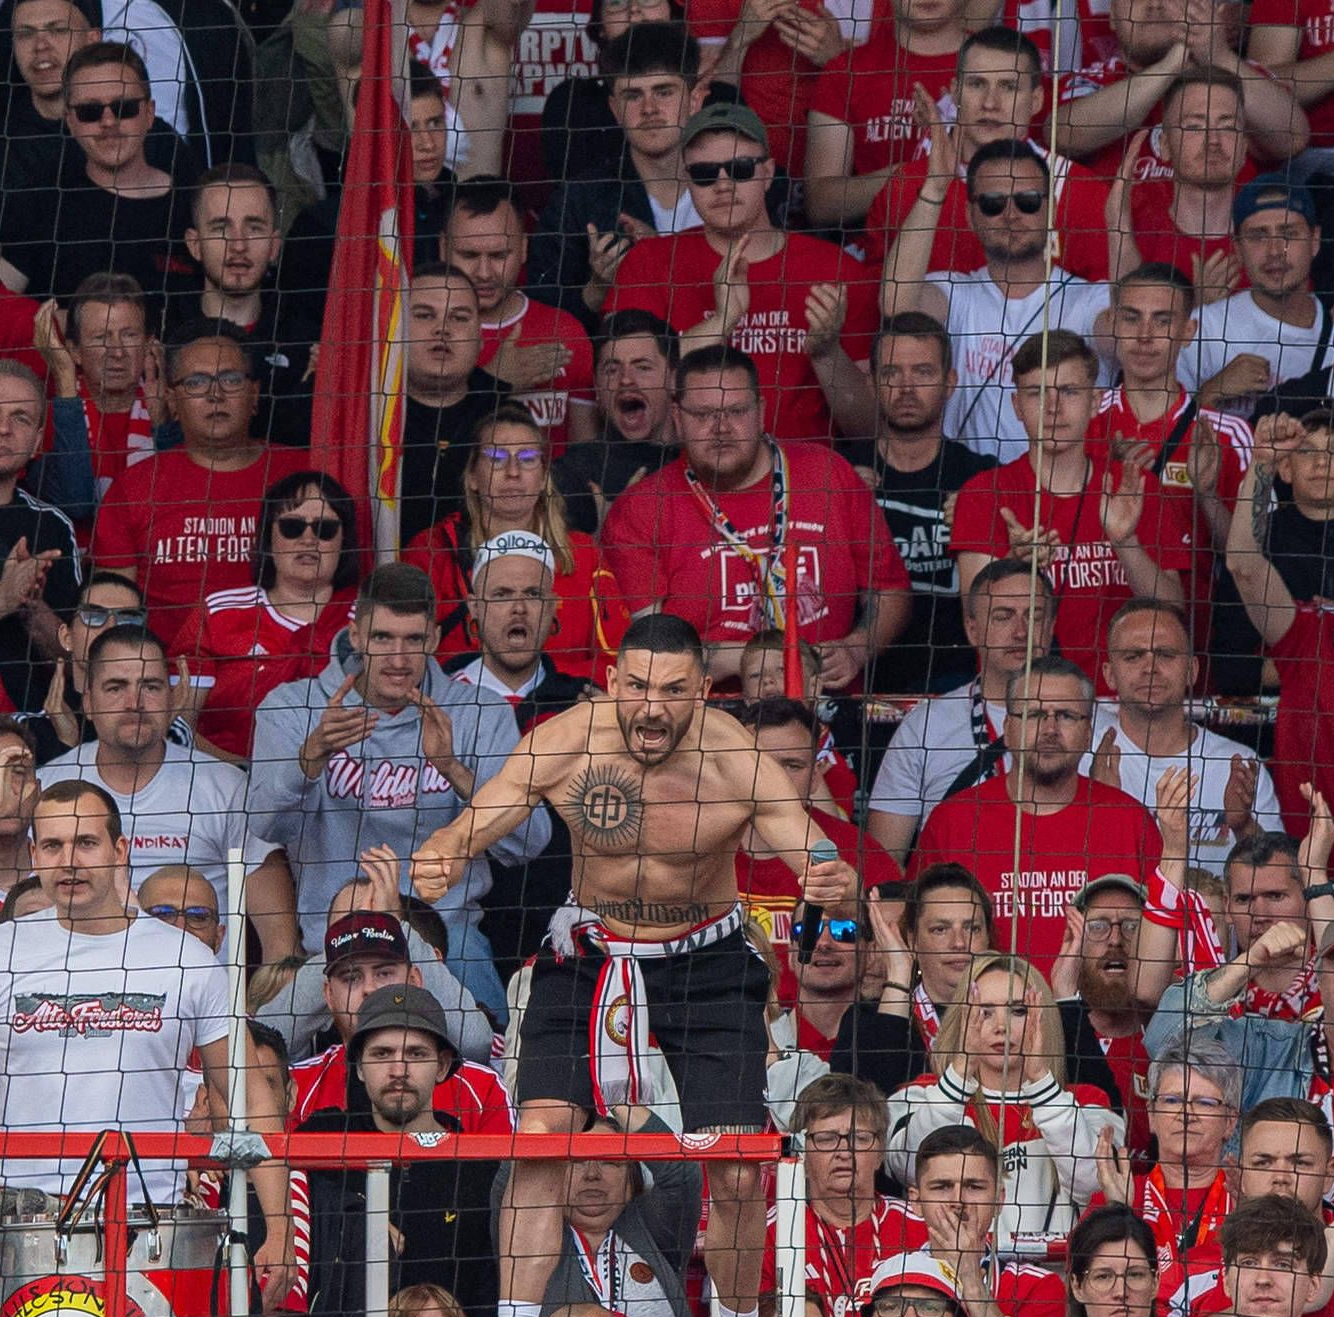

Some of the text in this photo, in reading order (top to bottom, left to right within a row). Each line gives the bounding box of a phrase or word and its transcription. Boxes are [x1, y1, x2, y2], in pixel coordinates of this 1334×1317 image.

[183, 518, 236, 535] STADION
[154, 538, 208, 565] ALTEN
[1000, 871, 1049, 888] STADION
[1051, 871, 1067, 886] AN
